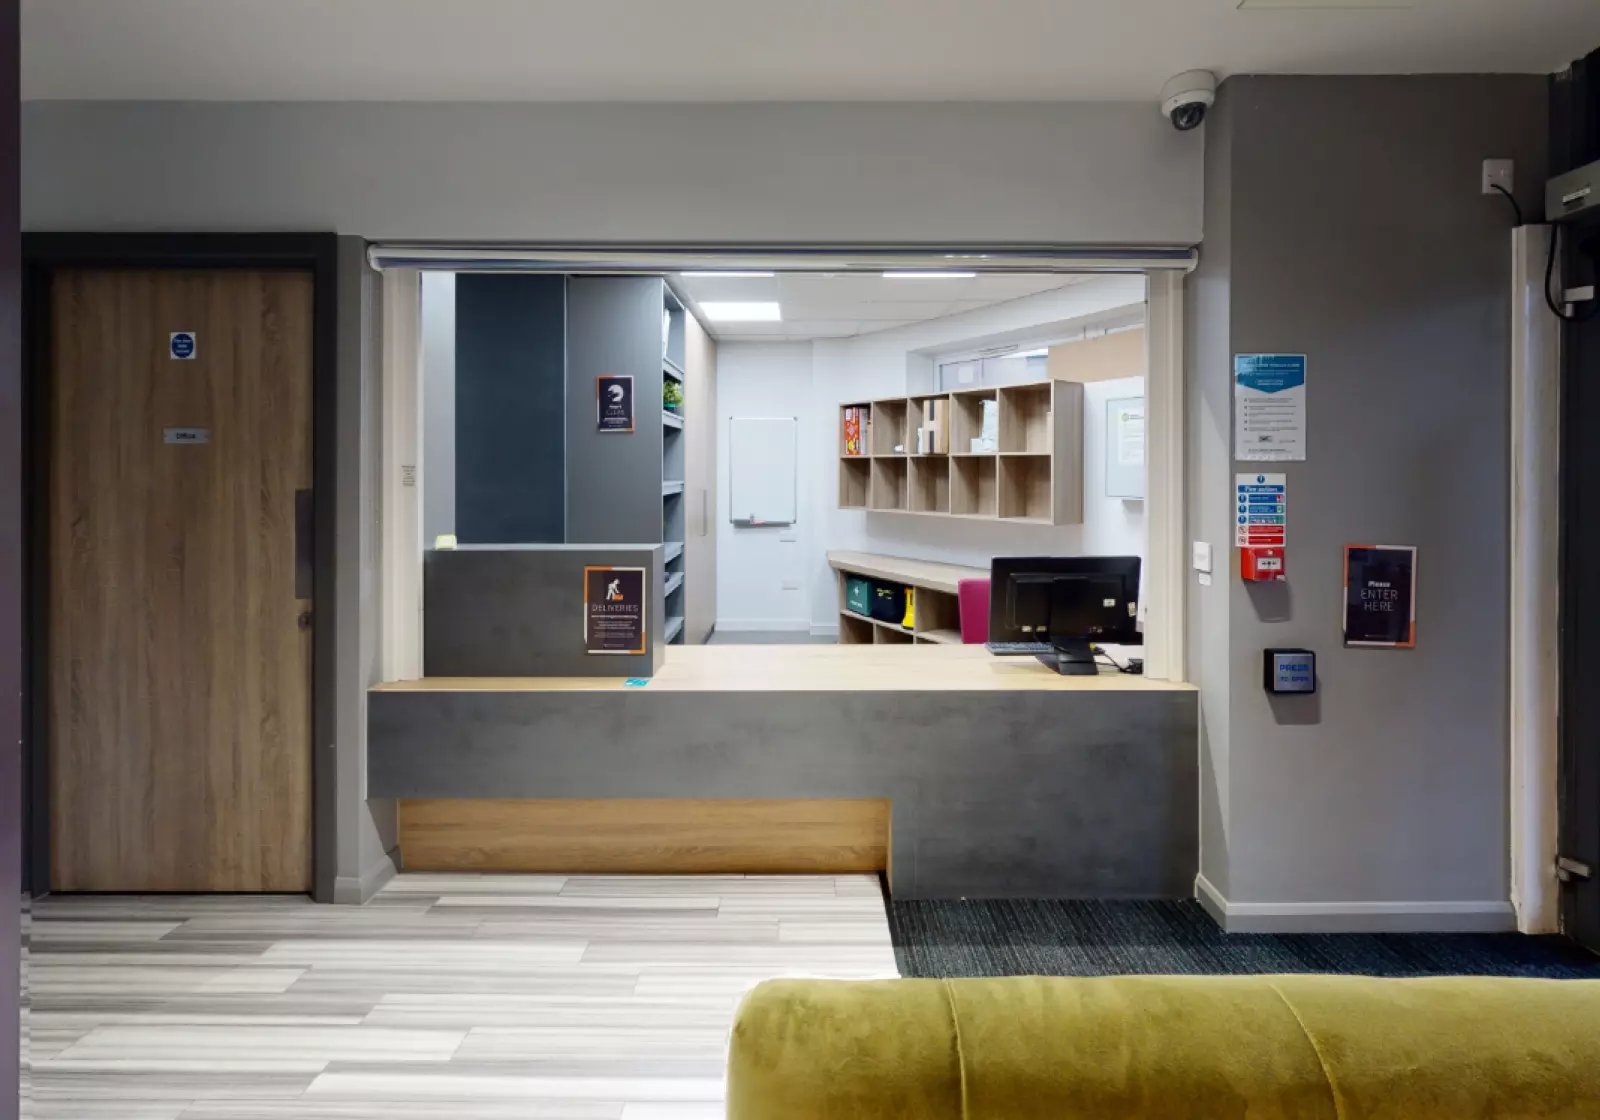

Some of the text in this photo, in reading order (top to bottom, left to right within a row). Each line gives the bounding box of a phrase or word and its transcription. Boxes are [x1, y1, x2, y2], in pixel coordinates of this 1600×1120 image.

[1361, 589, 1398, 600] ENTER
[592, 604, 639, 612] DELIVERIES
[1364, 601, 1394, 612] HERE
[1279, 663, 1310, 671] PRESS
